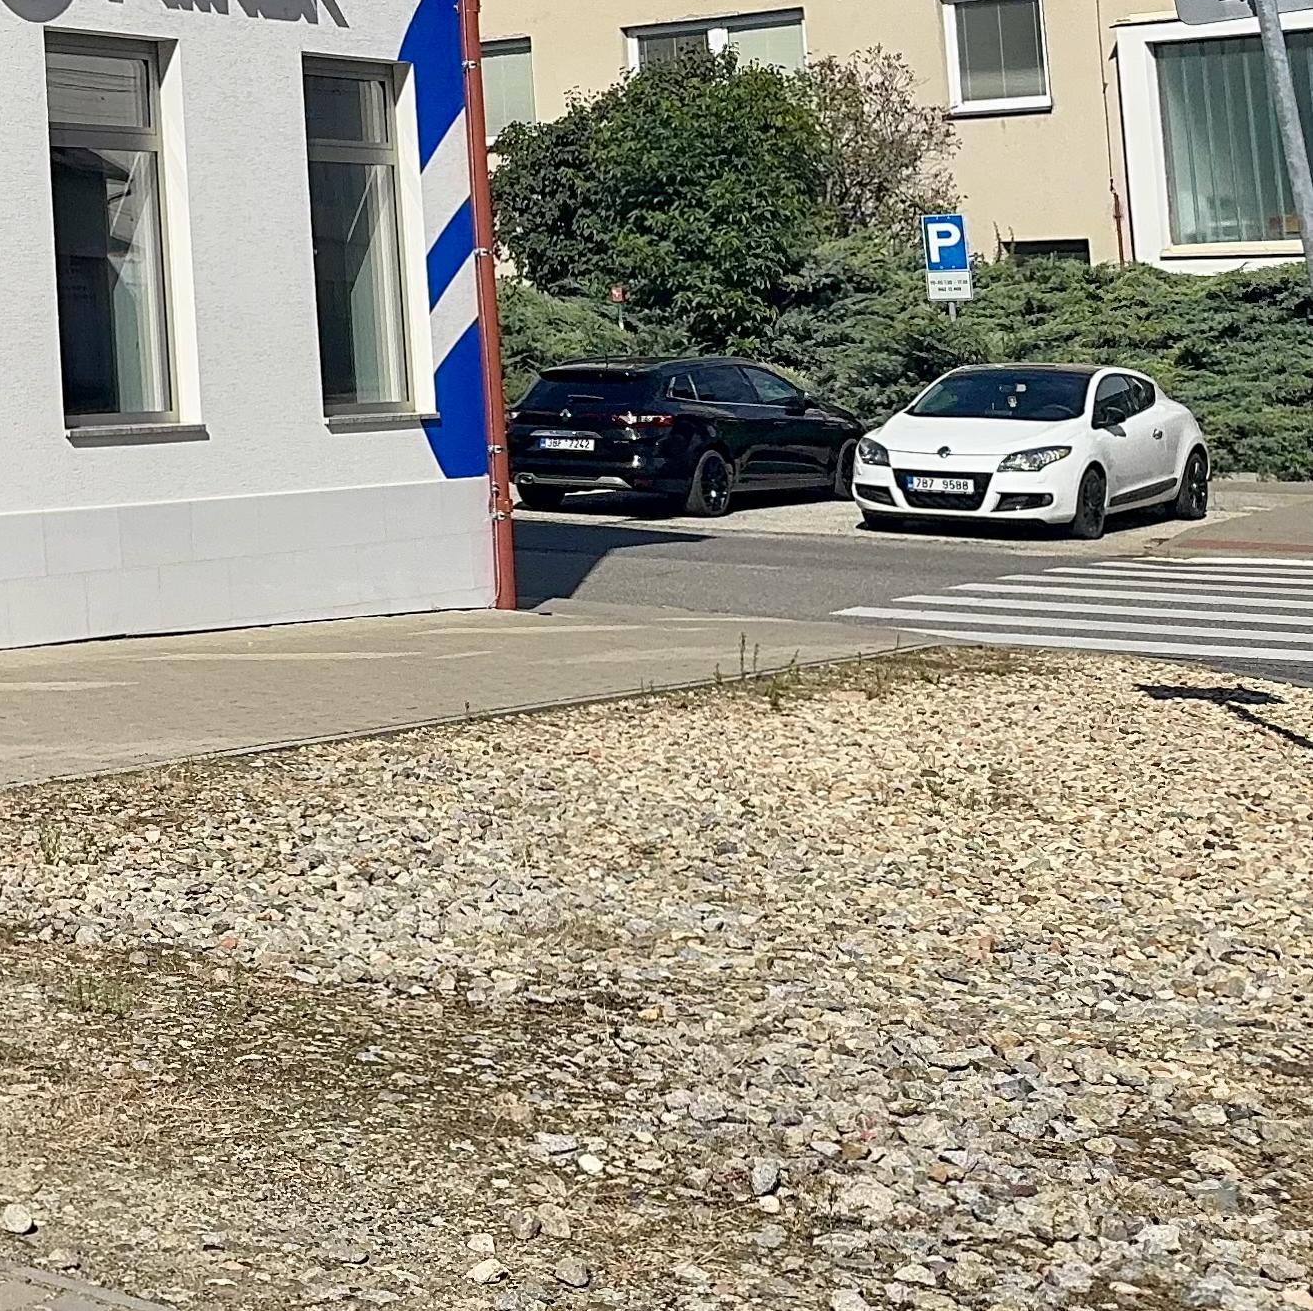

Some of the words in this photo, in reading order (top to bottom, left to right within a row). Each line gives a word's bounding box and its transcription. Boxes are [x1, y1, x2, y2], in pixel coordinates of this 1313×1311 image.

[927, 222, 961, 264] P
[916, 478, 934, 488] 7B7
[942, 480, 969, 490] 9588
